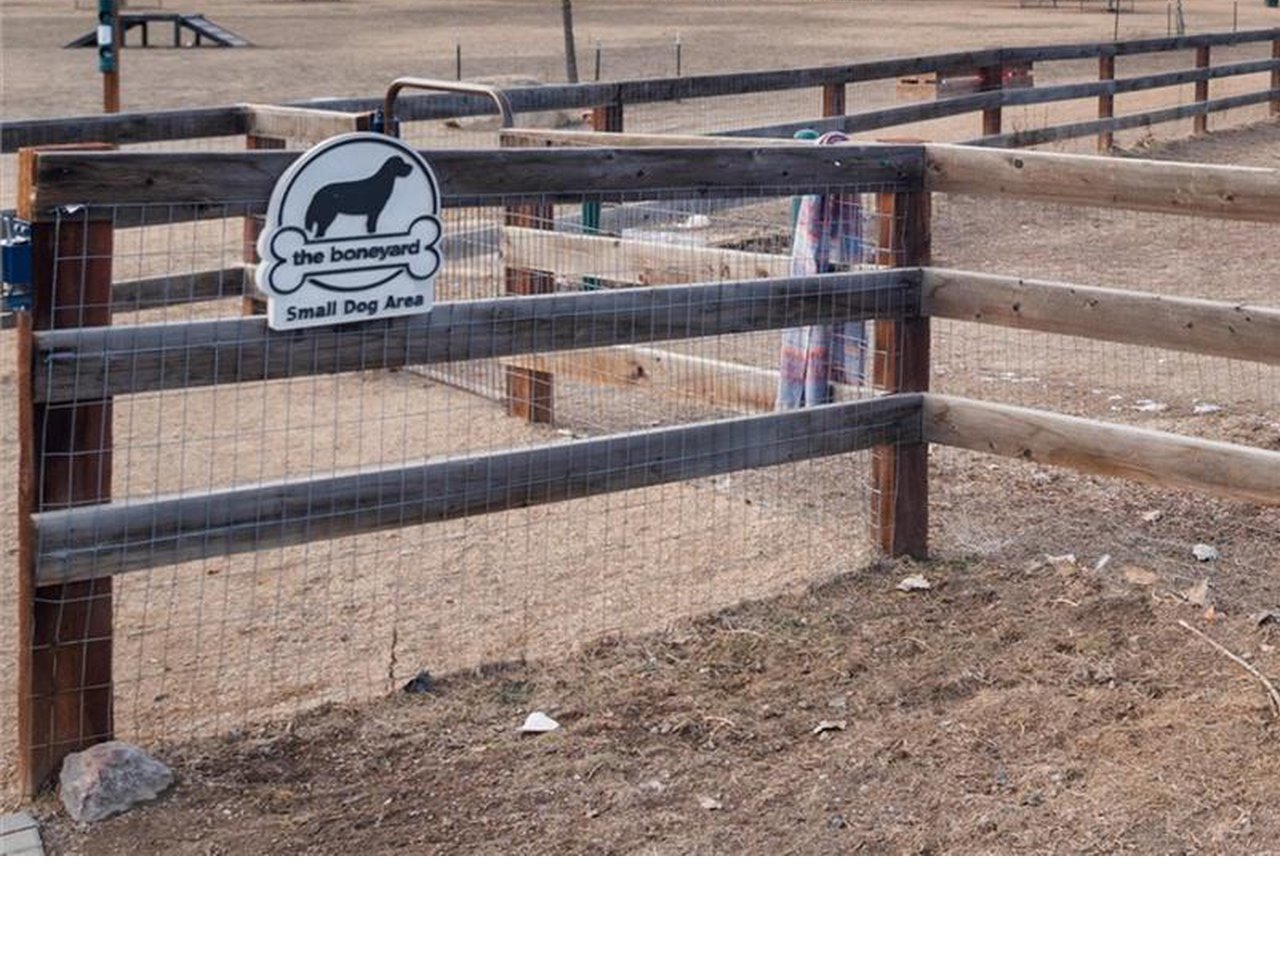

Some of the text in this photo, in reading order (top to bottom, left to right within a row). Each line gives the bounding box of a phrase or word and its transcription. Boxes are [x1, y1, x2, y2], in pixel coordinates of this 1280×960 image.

[292, 239, 420, 267] the boneyard
[286, 294, 424, 322] Small Dog Area
